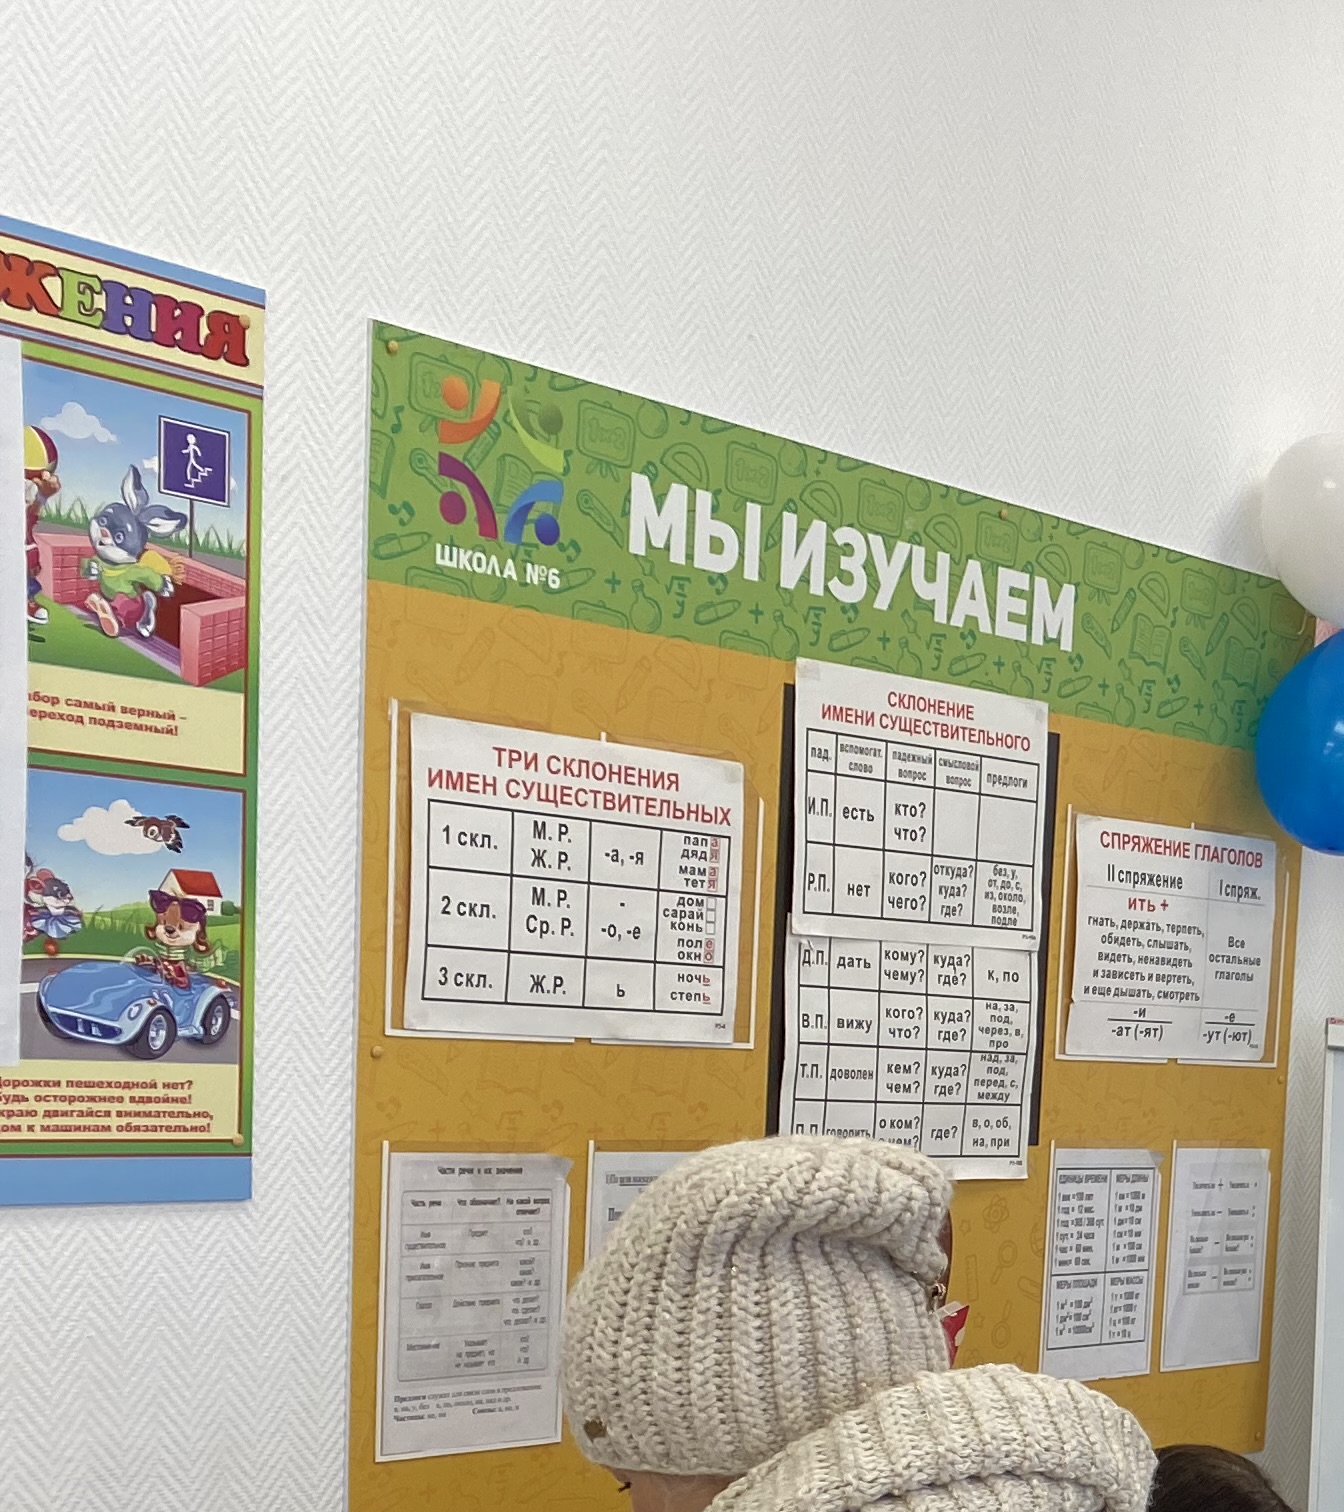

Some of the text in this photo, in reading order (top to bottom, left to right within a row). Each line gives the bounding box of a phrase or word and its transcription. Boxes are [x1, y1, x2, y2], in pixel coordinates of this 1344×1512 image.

[435, 542, 561, 590] ШКОЛА №6
[628, 471, 1076, 653] МЫ ИЗУЧАЕМ
[65, 697, 116, 713] самый
[120, 705, 176, 721] верный
[887, 691, 974, 721] СКЛОНЕНИЕ
[29, 709, 178, 736] ереход подземный!
[821, 703, 1031, 752] ИМЕНИ СУЩЕСТВИТЕЛЬНОГО
[811, 746, 832, 761] пад.
[492, 746, 679, 792] ТРИ СКЛОНЕНИЯ
[898, 769, 927, 782] вопрос
[987, 772, 1028, 790] предлоги
[428, 768, 731, 826] ИМЕН СУЩЕСТВИТЕЛЬНЫХ
[842, 805, 875, 822] есть
[894, 802, 926, 818] кто?
[442, 825, 498, 849] 1 скл.
[894, 826, 926, 842] что?
[683, 836, 719, 849] папа
[1100, 830, 1263, 868] СПРЯЖЕНИЕ ГЛАГОЛОВ
[681, 848, 719, 862] дядя
[679, 865, 718, 878] мама
[934, 864, 973, 879] откуда?
[1117, 868, 1183, 890] спряжение
[684, 877, 718, 891] тетя
[889, 871, 927, 888] кого?
[847, 881, 870, 897] нет
[938, 884, 967, 897] куда?
[1225, 884, 1261, 902] спряж.
[441, 895, 496, 919] 2 скл.
[676, 895, 704, 909] дом
[888, 894, 926, 911] чего?
[1128, 898, 1156, 912] ИТЬ
[662, 906, 704, 921] сарай
[941, 904, 963, 917] где?
[670, 921, 703, 933] конь
[1088, 915, 1204, 938] гнать, держать, терпеть,
[677, 937, 714, 949] поле
[1101, 933, 1192, 953] обидеть, слышать,
[1228, 936, 1245, 949] Все
[677, 950, 714, 962] окно
[837, 955, 871, 970] дать
[884, 950, 924, 965] кому?
[934, 954, 971, 969] куда?
[1098, 951, 1193, 969] видеть, ненавидеть
[1208, 953, 1261, 967] остальные
[438, 967, 493, 989] 3 скл.
[677, 971, 711, 986] ночь
[884, 968, 924, 985] чему?
[937, 971, 966, 987] где?
[1101, 968, 1194, 986] зависеть вертеть,
[1215, 970, 1253, 982] глаголы
[670, 989, 711, 1004] степь
[1092, 986, 1200, 1002] еще дышать, смотреть
[886, 1007, 923, 1021] кого?
[934, 1010, 971, 1024] куда?
[837, 1017, 873, 1033] вижу
[888, 1025, 920, 1039] что?
[937, 1028, 966, 1043] где?
[830, 1068, 873, 1082] доволен
[887, 1062, 920, 1075] кем?
[931, 1064, 966, 1077] куда?
[0, 1078, 193, 1091] орожки пешеходной нет?
[886, 1080, 920, 1094] чем?
[934, 1083, 961, 1096] где?
[0, 1093, 192, 1105] удь осторожнее вдвойне!
[977, 1090, 1010, 1102] между
[42, 1108, 111, 1119] двигайся
[116, 1109, 213, 1121] внимательно,
[40, 1123, 111, 1133] машинам
[116, 1123, 211, 1134] обязательно!
[931, 1125, 958, 1140] где?
